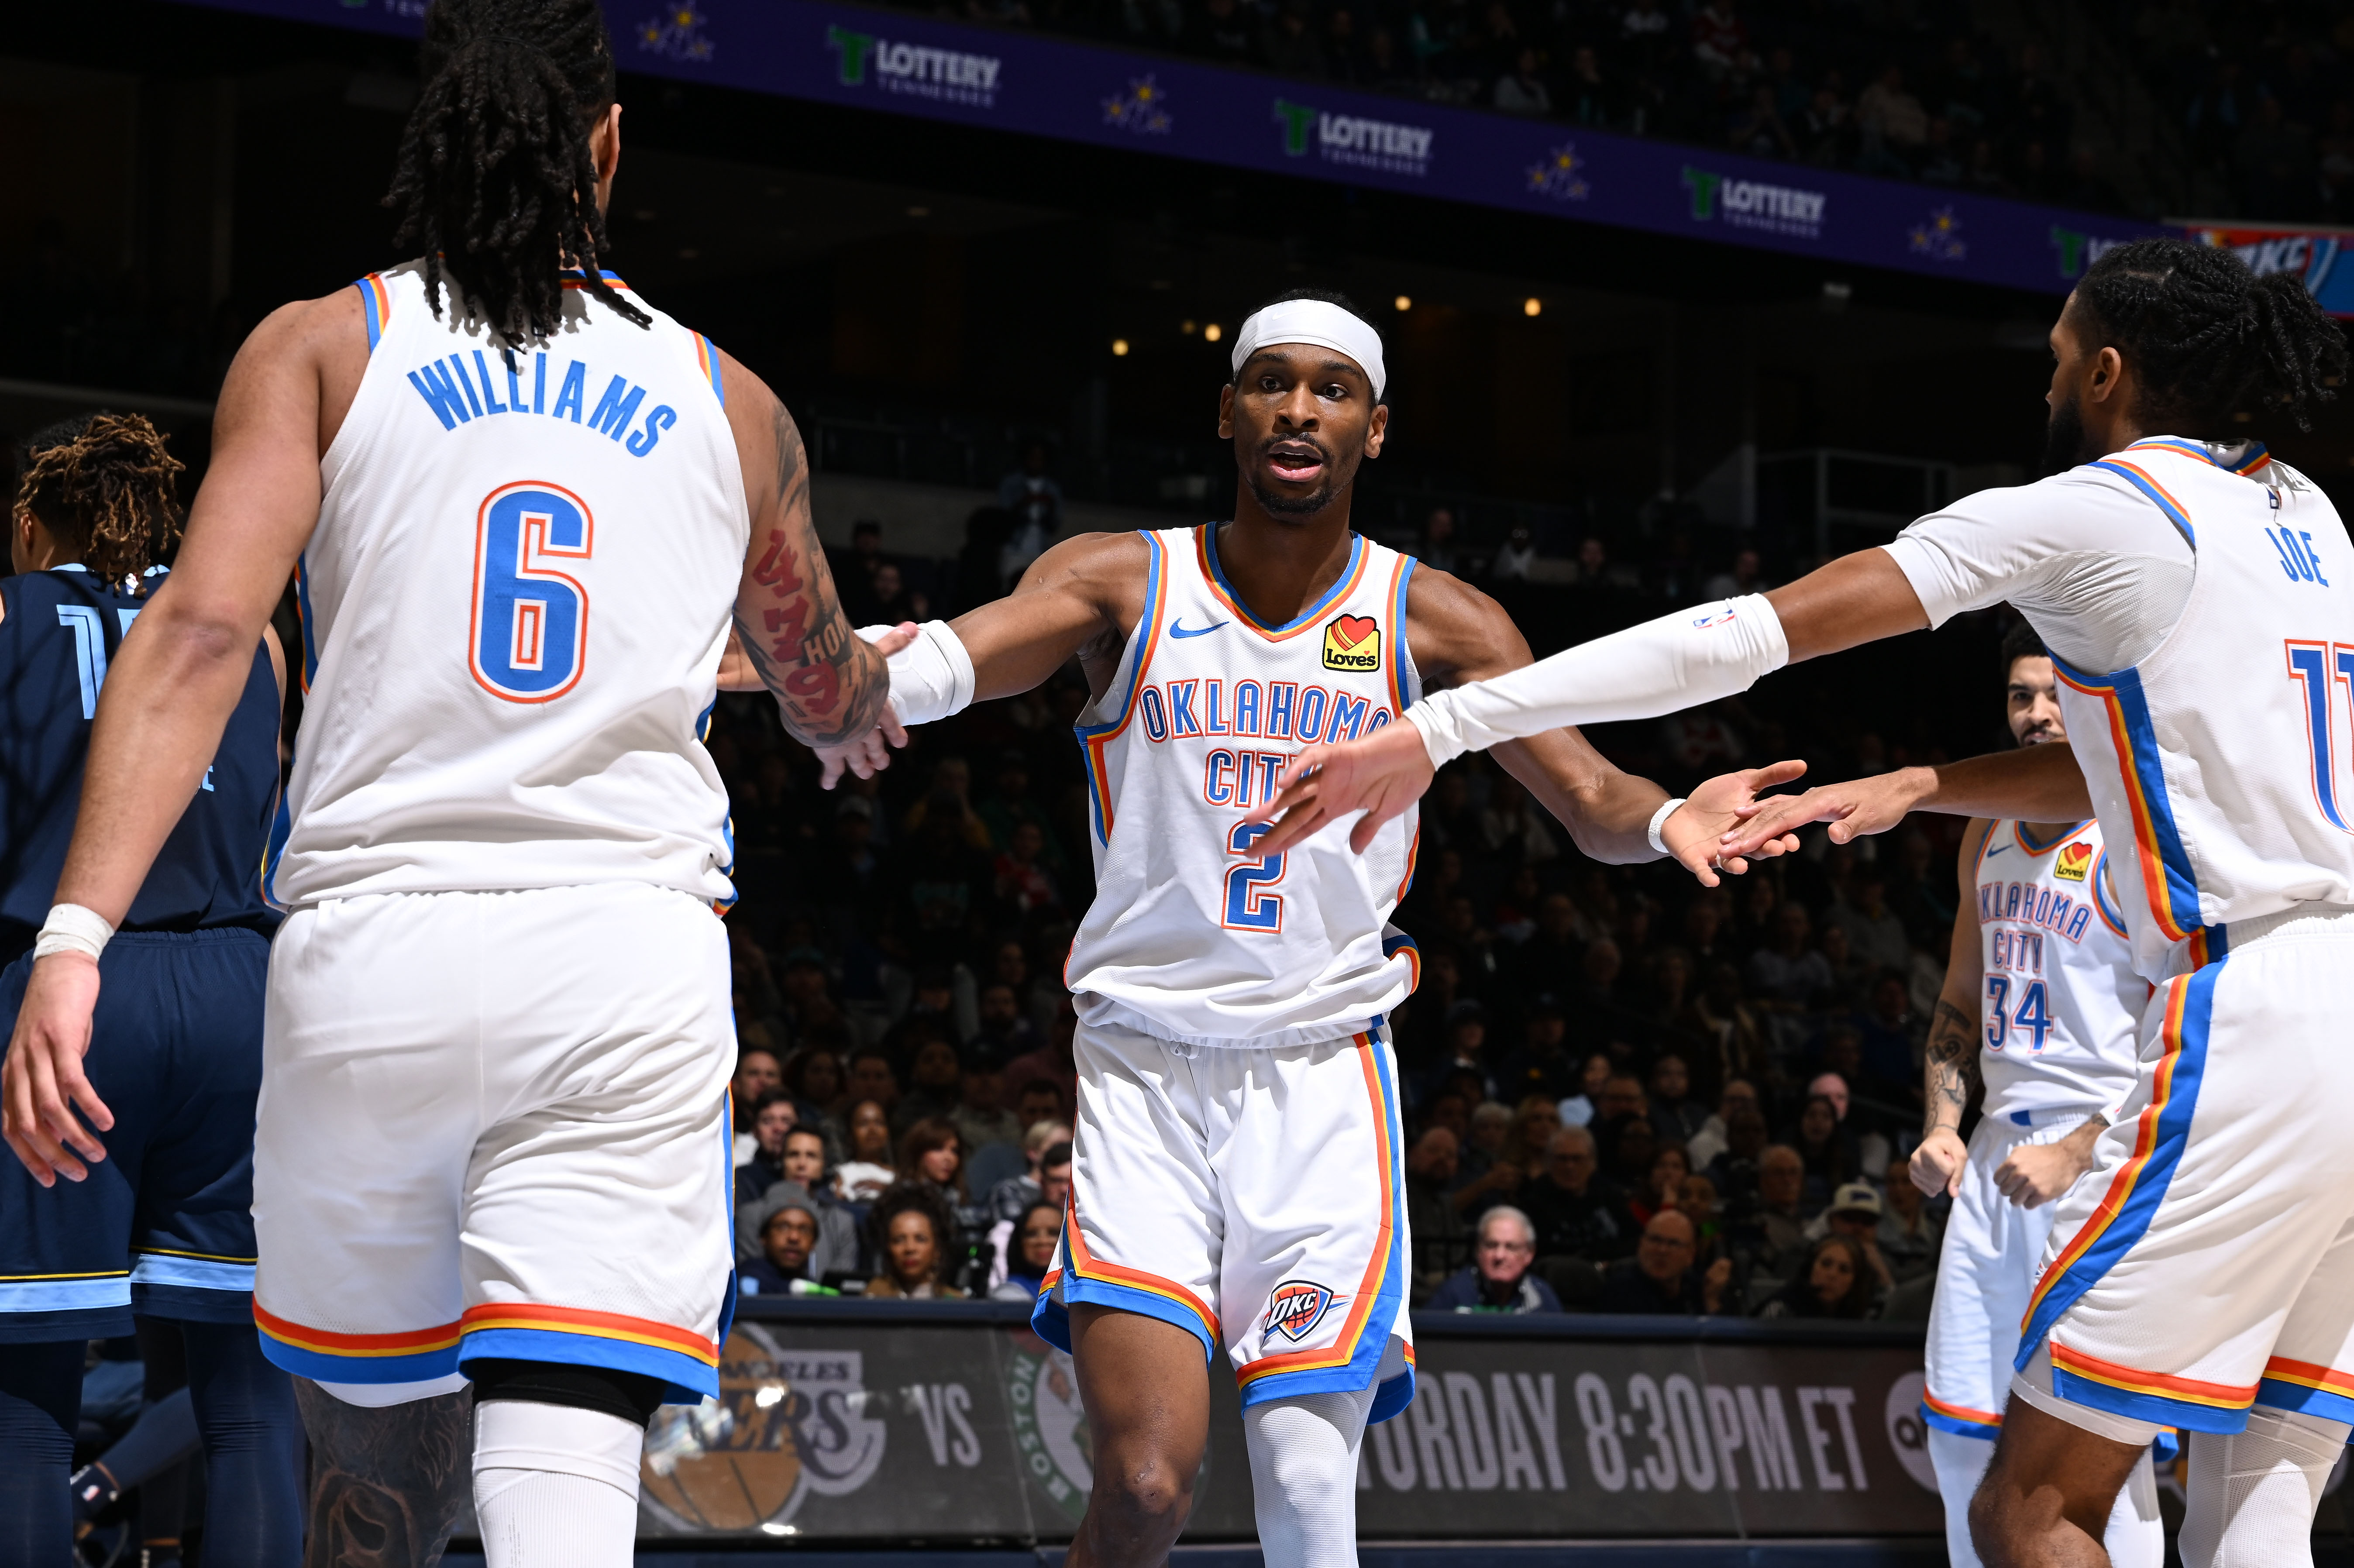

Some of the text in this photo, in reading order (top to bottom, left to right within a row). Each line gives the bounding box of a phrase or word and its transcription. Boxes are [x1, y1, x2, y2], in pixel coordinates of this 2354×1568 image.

[875, 40, 1000, 89] LOTTERY
[1320, 112, 1433, 158] LOTTERY
[1722, 178, 1826, 221] LOTTERY
[407, 350, 677, 457] WILLIAMS
[2264, 527, 2329, 587] JOE
[468, 480, 593, 703] 6
[57, 604, 142, 719] 1
[1204, 748, 1322, 808] CIT
[1222, 820, 1287, 934] 2
[1977, 882, 2092, 944] KLAHOMA
[1993, 928, 2043, 973] CITY
[1986, 973, 2054, 1054] 34
[1265, 1290, 1318, 1333] OKC
[912, 1382, 981, 1467] VS
[1574, 1372, 1803, 1492] 8:30PM
[1795, 1386, 1869, 1490] ET
